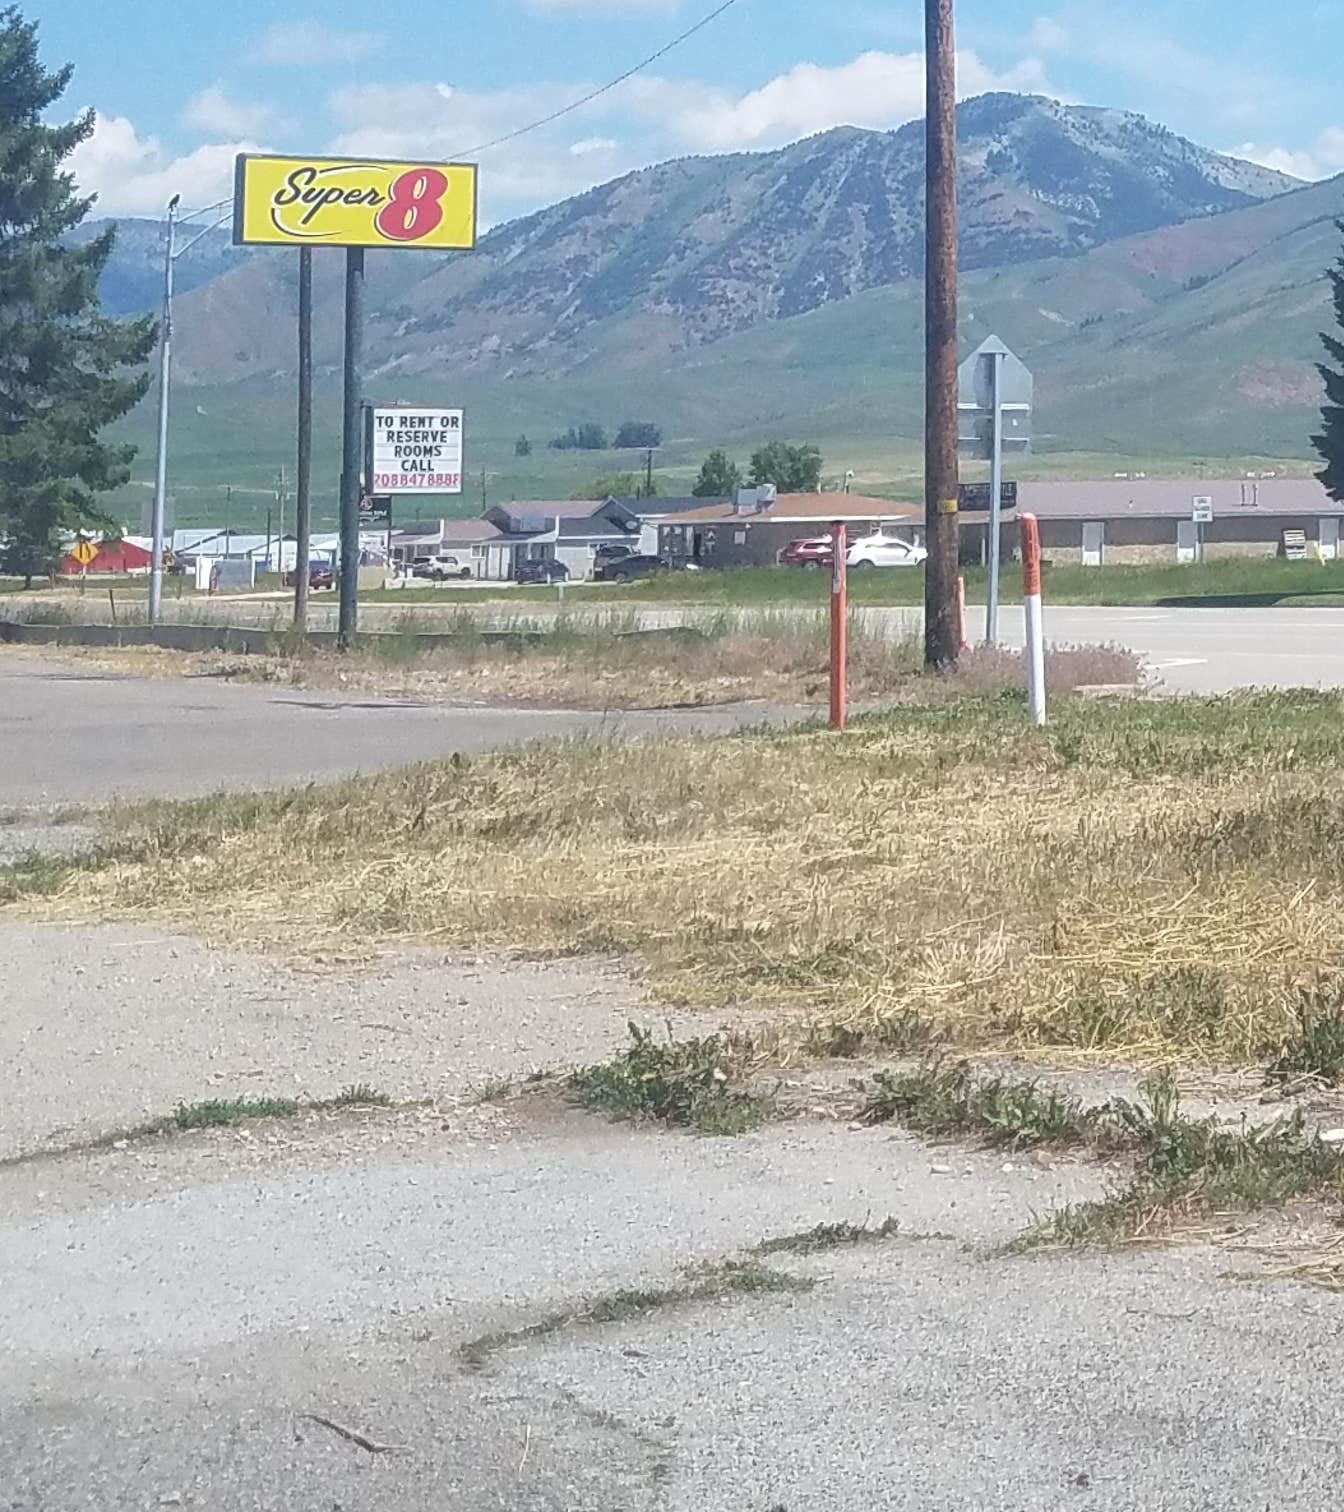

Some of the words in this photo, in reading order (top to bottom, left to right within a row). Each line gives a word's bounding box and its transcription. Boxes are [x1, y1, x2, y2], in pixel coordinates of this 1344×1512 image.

[273, 166, 386, 225] Super
[376, 167, 449, 241] 8
[375, 415, 394, 429] TO
[399, 415, 434, 429] RENT
[440, 415, 459, 429] OR
[386, 430, 448, 443] RESERVE
[394, 445, 442, 458] ROOMS
[401, 459, 435, 472] CALL
